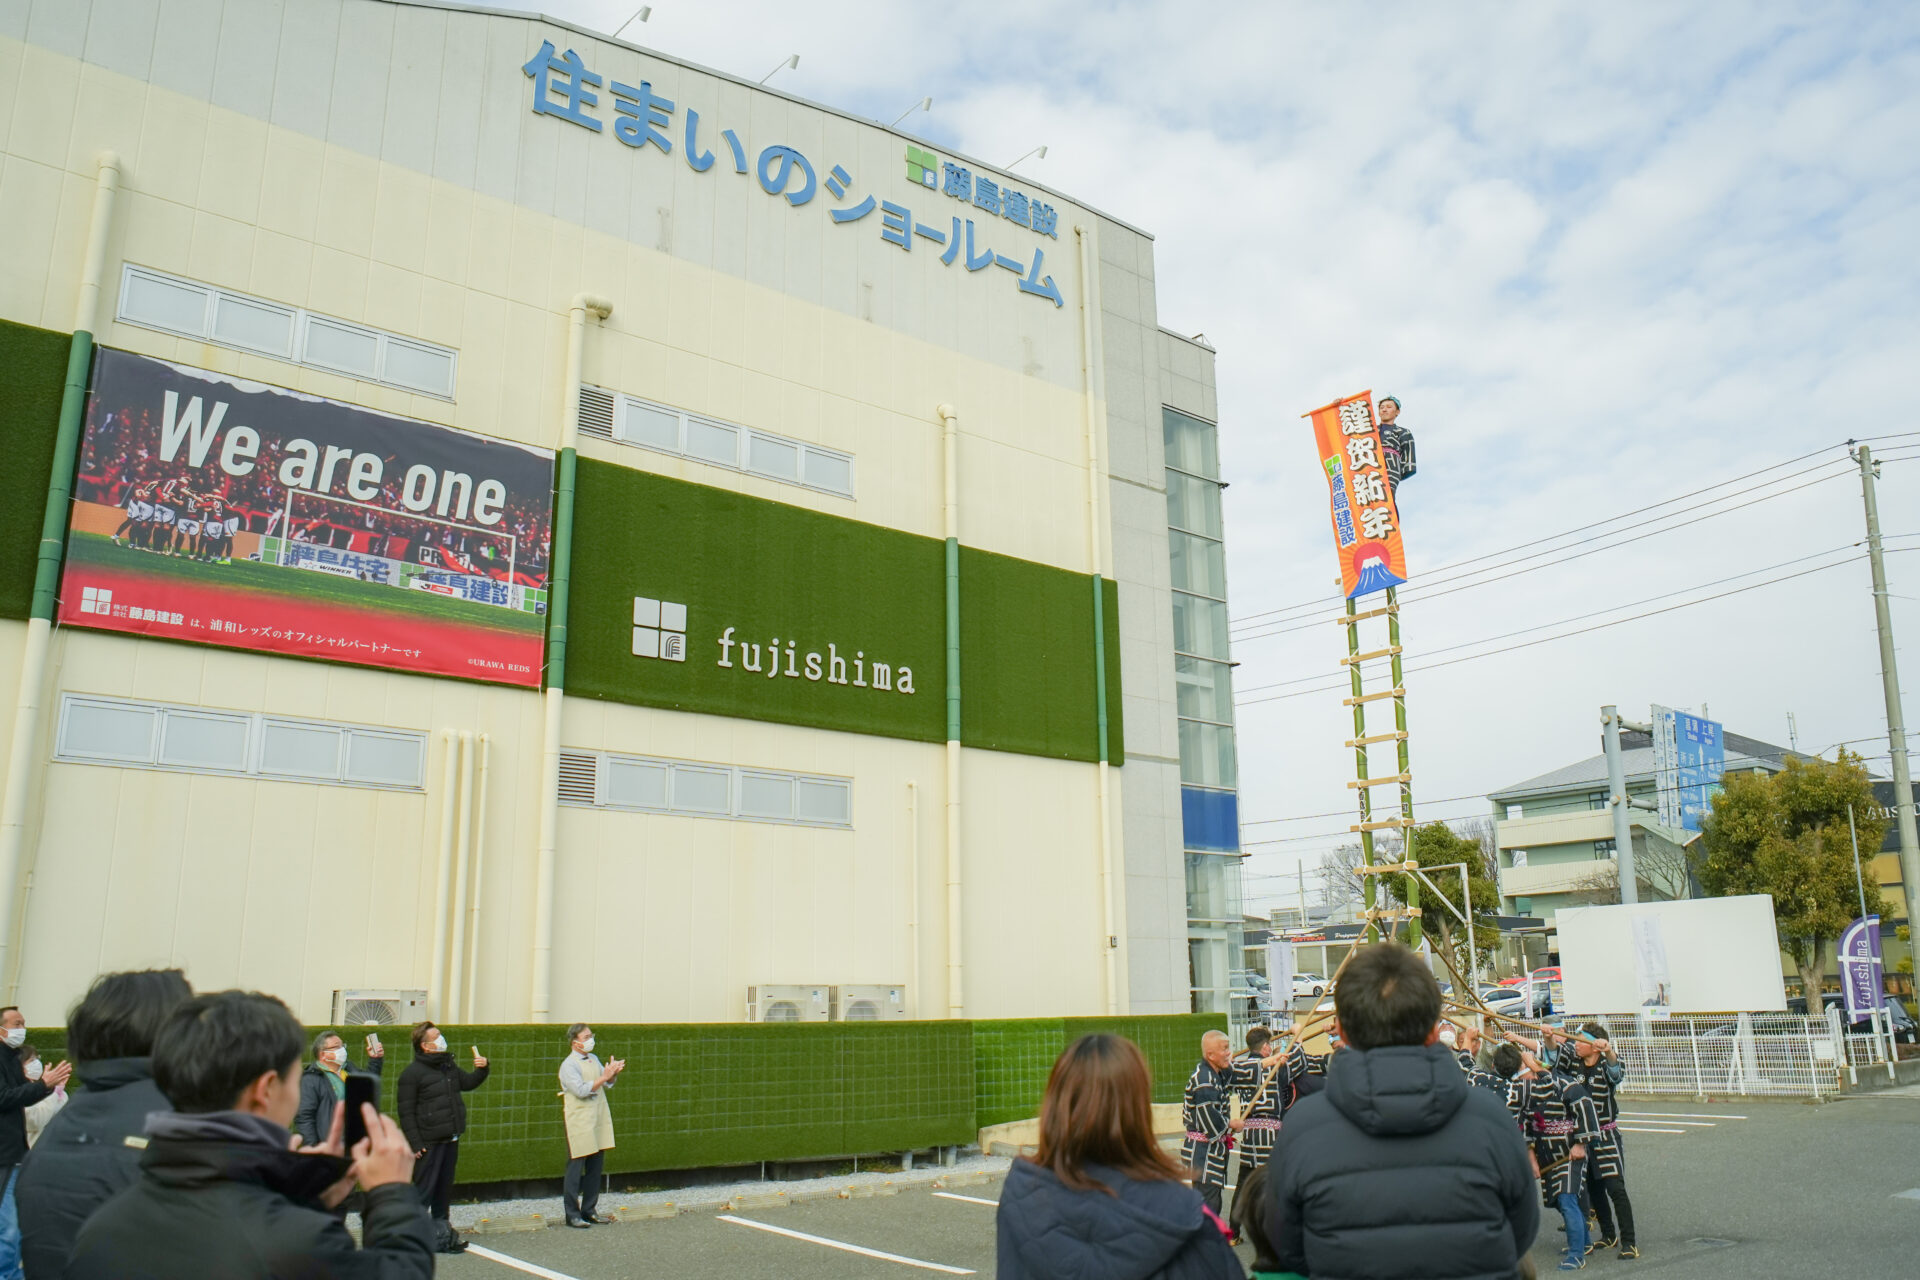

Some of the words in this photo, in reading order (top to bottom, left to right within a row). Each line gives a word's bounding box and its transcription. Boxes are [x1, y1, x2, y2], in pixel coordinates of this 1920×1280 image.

[522, 38, 1064, 307] 住まいのショールーム
[942, 161, 1058, 240] 藤島建設
[158, 390, 261, 476] We
[279, 439, 383, 500] are
[403, 463, 507, 525] one
[1338, 400, 1395, 540] 謹賀新年
[1332, 473, 1356, 547] 藤島建設
[129, 606, 185, 626] 藤島建設
[508, 663, 531, 673] REDS
[717, 627, 916, 694] fujishima
